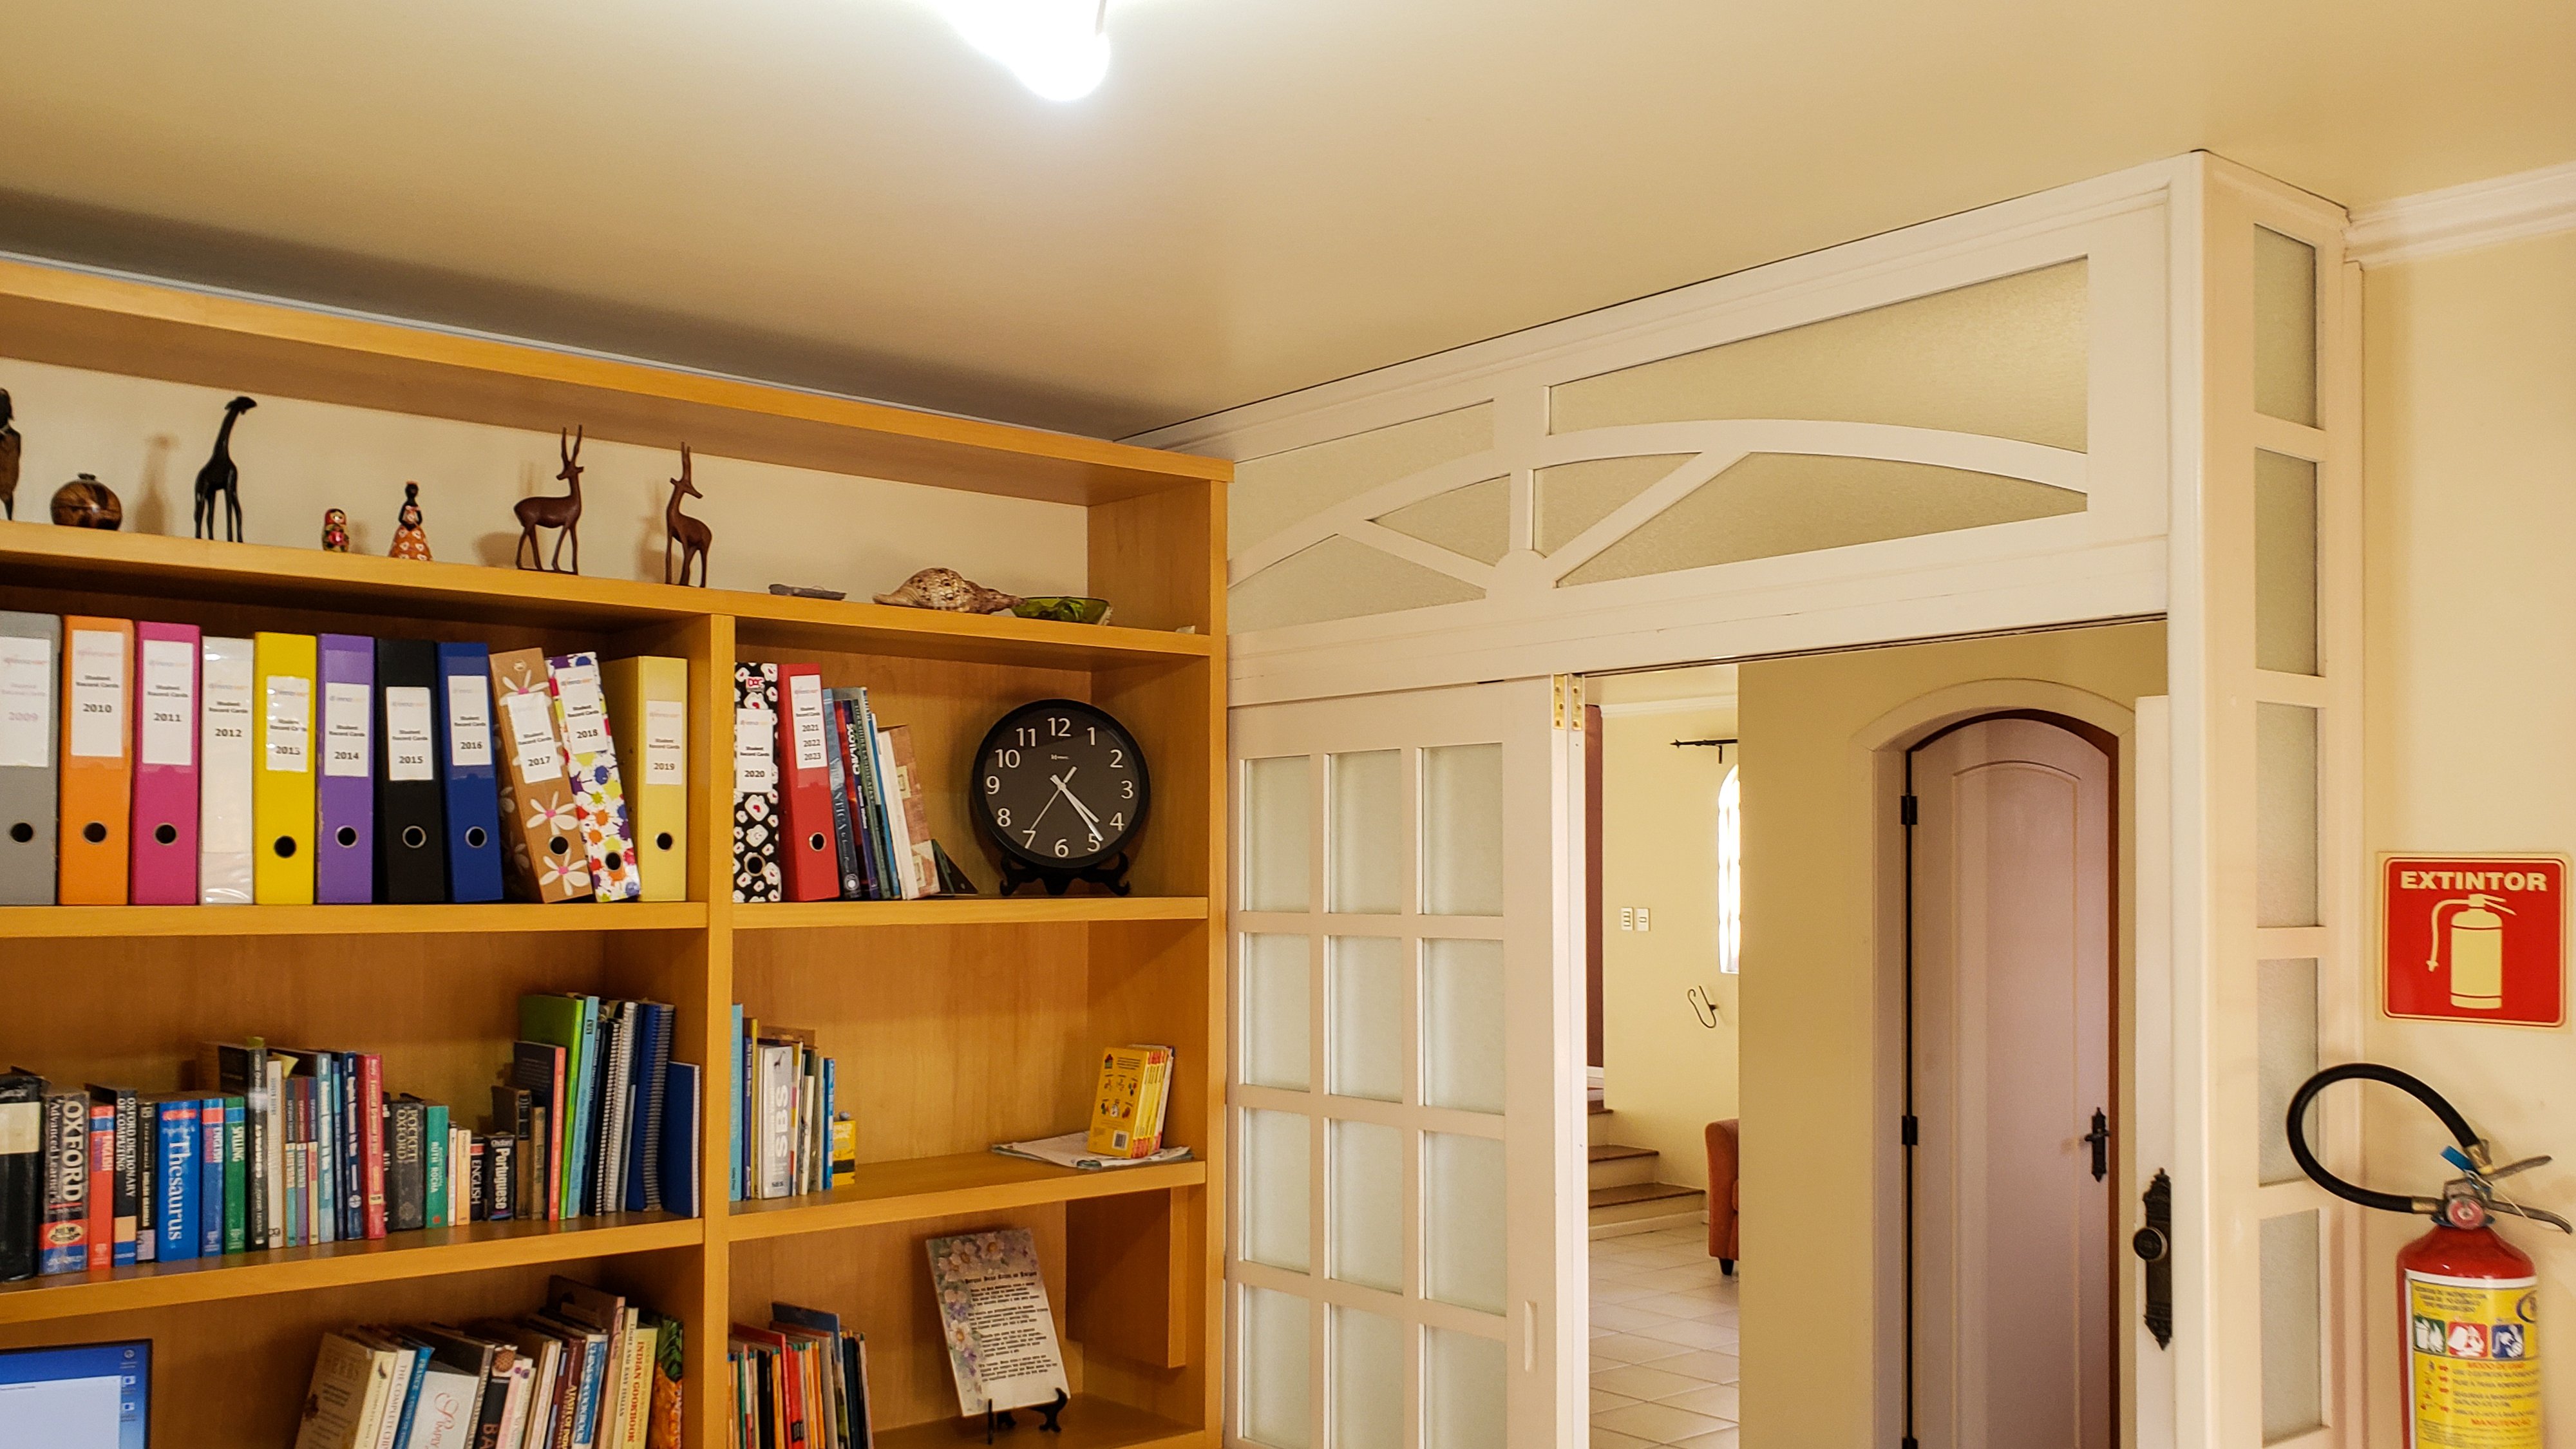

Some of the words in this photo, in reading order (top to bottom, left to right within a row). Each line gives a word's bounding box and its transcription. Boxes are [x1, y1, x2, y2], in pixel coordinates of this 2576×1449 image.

[83, 703, 112, 713] 2010
[153, 713, 182, 722] 2011
[215, 728, 242, 737] 2012
[576, 728, 598, 739] 2018
[802, 724, 820, 732] 2021
[1016, 728, 1036, 746] 11
[1047, 717, 1072, 737] 12
[1087, 727, 1095, 746] 1
[460, 741, 483, 750] 2016
[803, 739, 821, 747] 2022
[846, 722, 860, 775] SCOTLAND
[334, 751, 360, 760] 2014
[399, 755, 424, 764] 2015
[527, 756, 551, 767] 2017
[804, 752, 822, 761] 2023
[995, 749, 1021, 768] 10
[1110, 749, 1123, 768] 2
[653, 762, 676, 771] 2019
[744, 770, 766, 778] 2020
[986, 775, 1000, 795] 9
[1121, 780, 1133, 799] 3
[997, 808, 1011, 828] 8
[1109, 812, 1125, 831] 4
[1023, 830, 1036, 849] 7
[1054, 838, 1069, 858] 6
[1086, 833, 1101, 852] 5
[2400, 871, 2548, 891] EXTINTOR
[116, 1097, 126, 1111] OF
[49, 1103, 62, 1151] Advanced
[126, 1097, 136, 1137] OXFORD
[775, 1084, 789, 1158] SBS
[116, 1113, 126, 1171] COMPUTING
[232, 1126, 244, 1162] SPELLING
[395, 1109, 406, 1160] OXFORD
[406, 1109, 417, 1159] POCKET
[64, 1100, 84, 1202] OXFORD
[102, 1135, 113, 1171] ENGLISH
[212, 1127, 223, 1163] ENGLISH
[126, 1138, 136, 1197] DICTIONARY
[167, 1136, 192, 1240] Thesaurus
[430, 1167, 439, 1193] ROCHA
[471, 1159, 482, 1204] ENGLISH
[494, 1148, 511, 1209] Portuguese
[634, 1342, 645, 1379] INDIAN
[398, 1365, 408, 1380] THE
[412, 1359, 424, 1390] FRANCE
[386, 1383, 403, 1430] COMPLETE
[619, 1388, 627, 1417] ITALIAN
[627, 1383, 641, 1443] COOKBOOK
